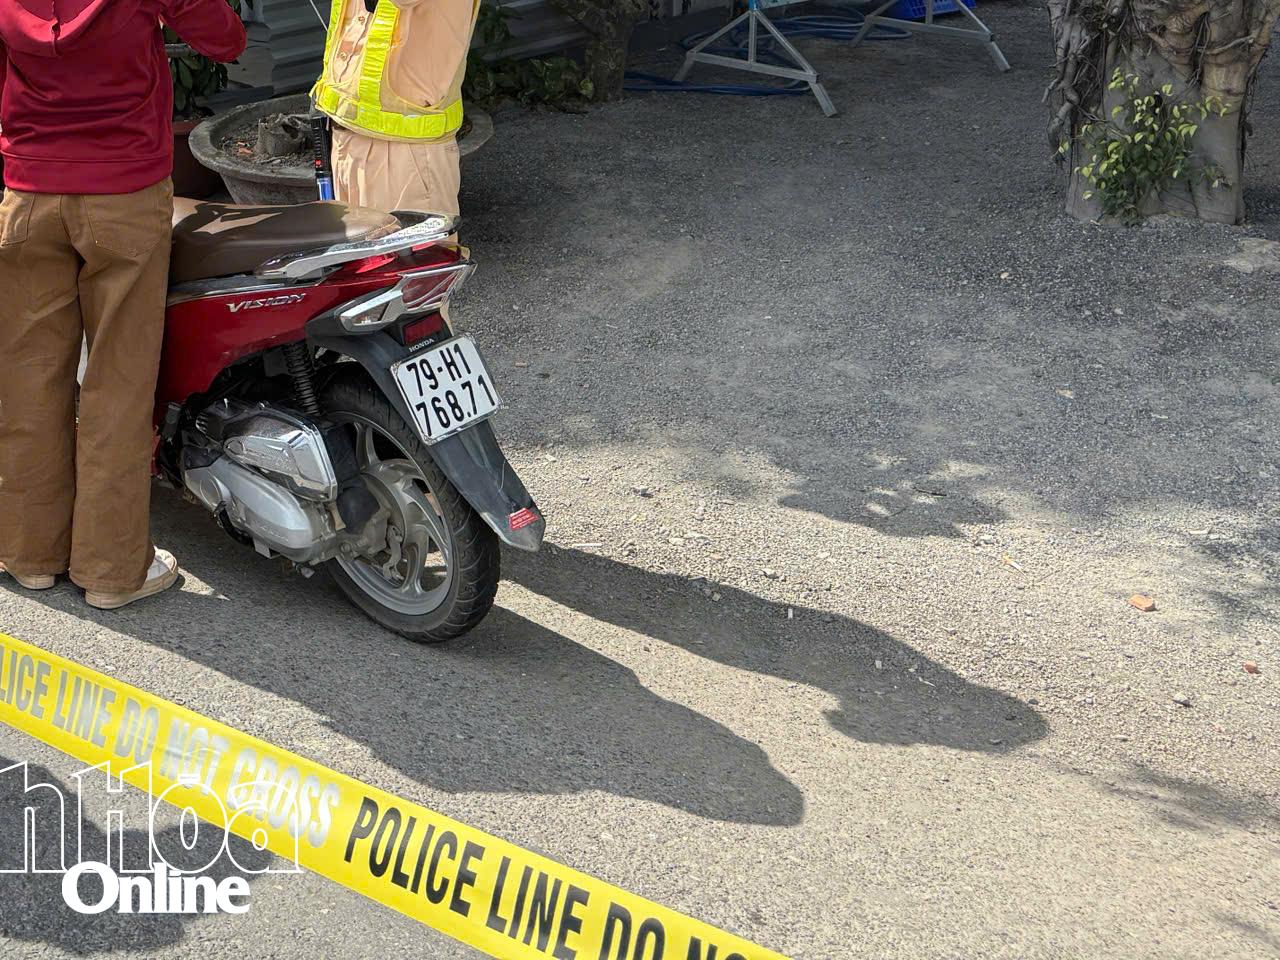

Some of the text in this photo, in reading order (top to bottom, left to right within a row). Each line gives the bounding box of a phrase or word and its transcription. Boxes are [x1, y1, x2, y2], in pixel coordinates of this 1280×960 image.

[226, 293, 306, 313] VISION
[405, 343, 472, 397] 79-H1
[408, 338, 435, 353] HONDA
[415, 374, 496, 437] 768.71
[52, 669, 119, 748] LINE
[113, 698, 160, 765] DO
[158, 717, 233, 797] NOT
[225, 746, 342, 848] CROSS
[343, 796, 486, 917] POLICE
[485, 856, 590, 960] LINE
